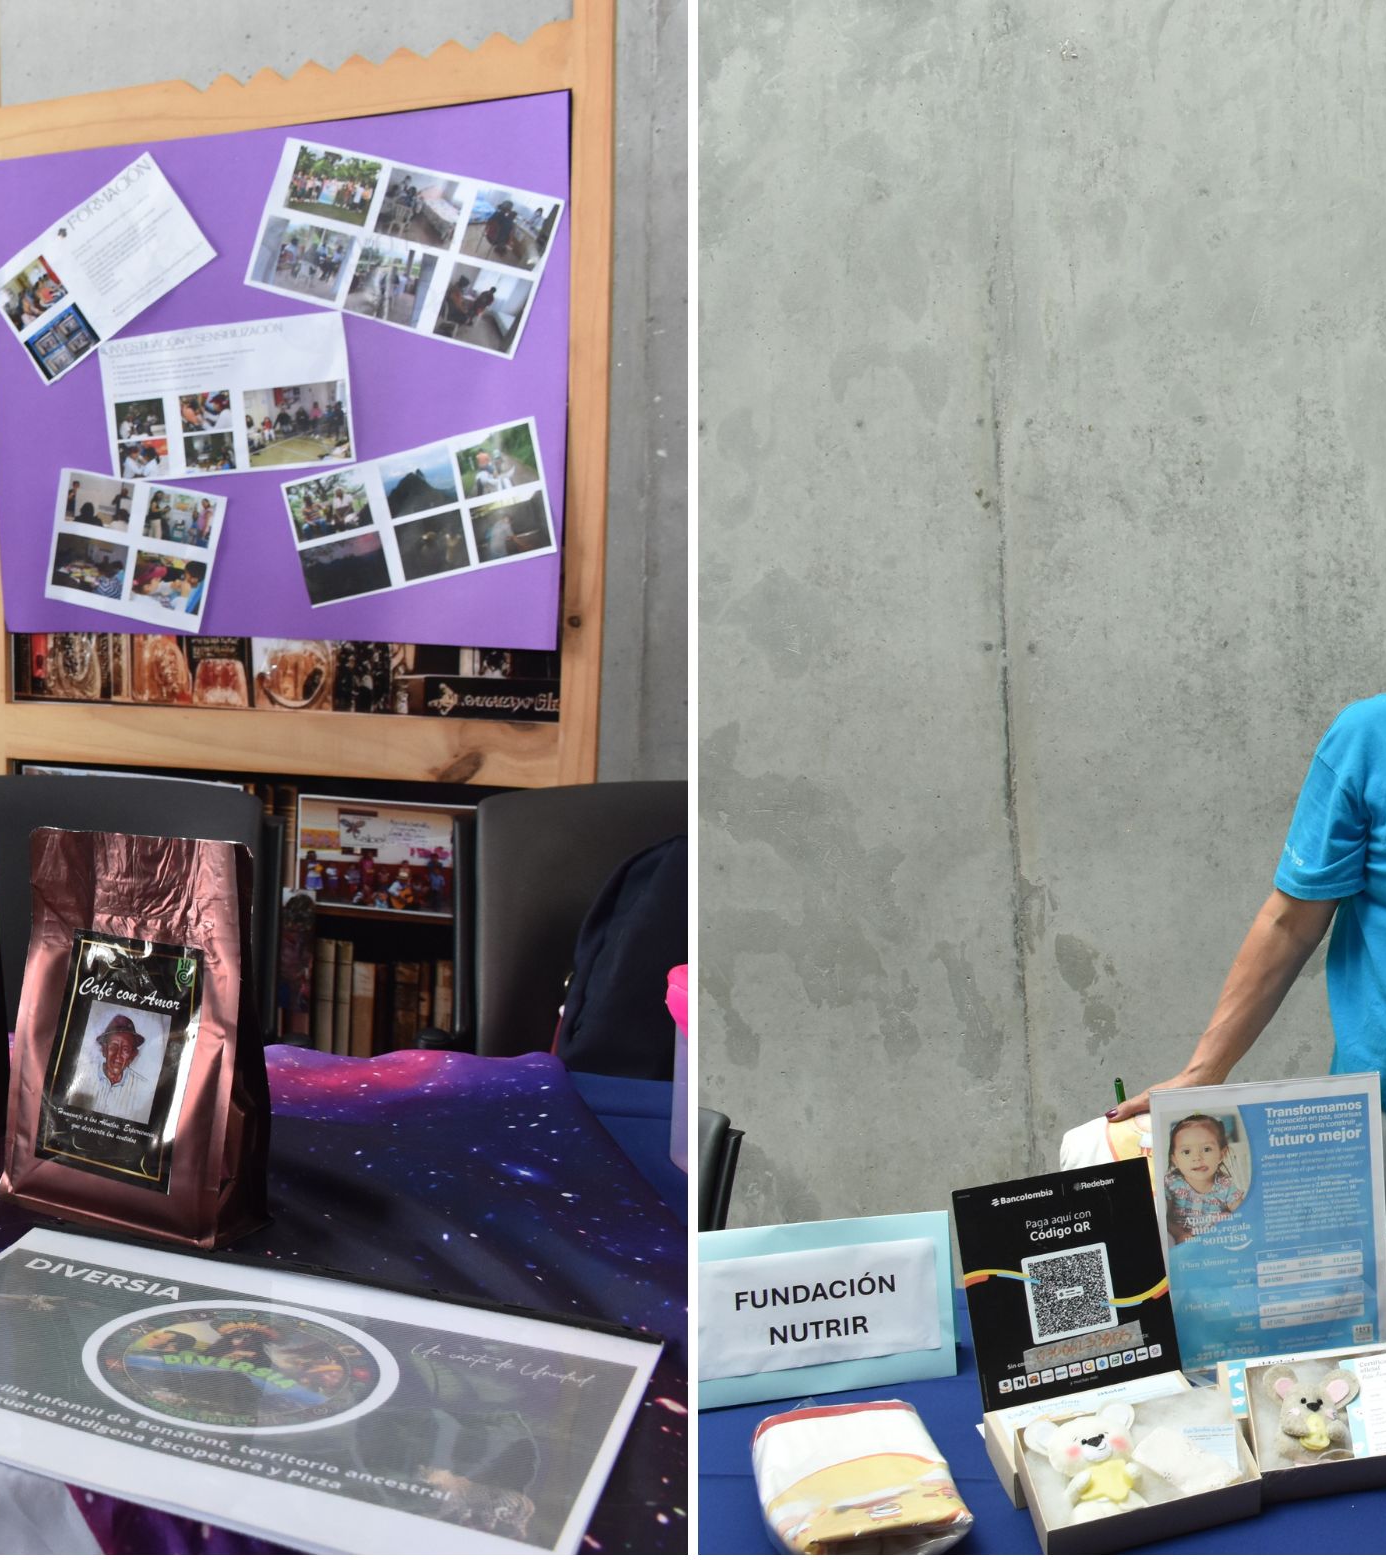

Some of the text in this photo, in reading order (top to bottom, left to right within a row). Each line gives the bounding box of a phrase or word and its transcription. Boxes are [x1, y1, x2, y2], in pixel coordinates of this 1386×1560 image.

[79, 976, 181, 1011] Café con Amor
[1265, 1101, 1362, 1118] Transformamos
[1269, 1127, 1362, 1147] futuro mejor
[1000, 1178, 1114, 1205] Bancolombia Redeban
[1025, 1210, 1092, 1230] Paga aquí con
[1030, 1221, 1092, 1243] Código QR
[25, 1257, 181, 1301] DIVERSIA
[734, 1272, 897, 1312] FUNDACIÓN
[768, 1315, 869, 1346] NUTRIR
[107, 1413, 131, 1426] de
[135, 1420, 231, 1451] Bonafont,
[239, 1444, 339, 1474] territorio
[345, 1468, 453, 1503] ancestral
[150, 1437, 262, 1472] Escopetera
